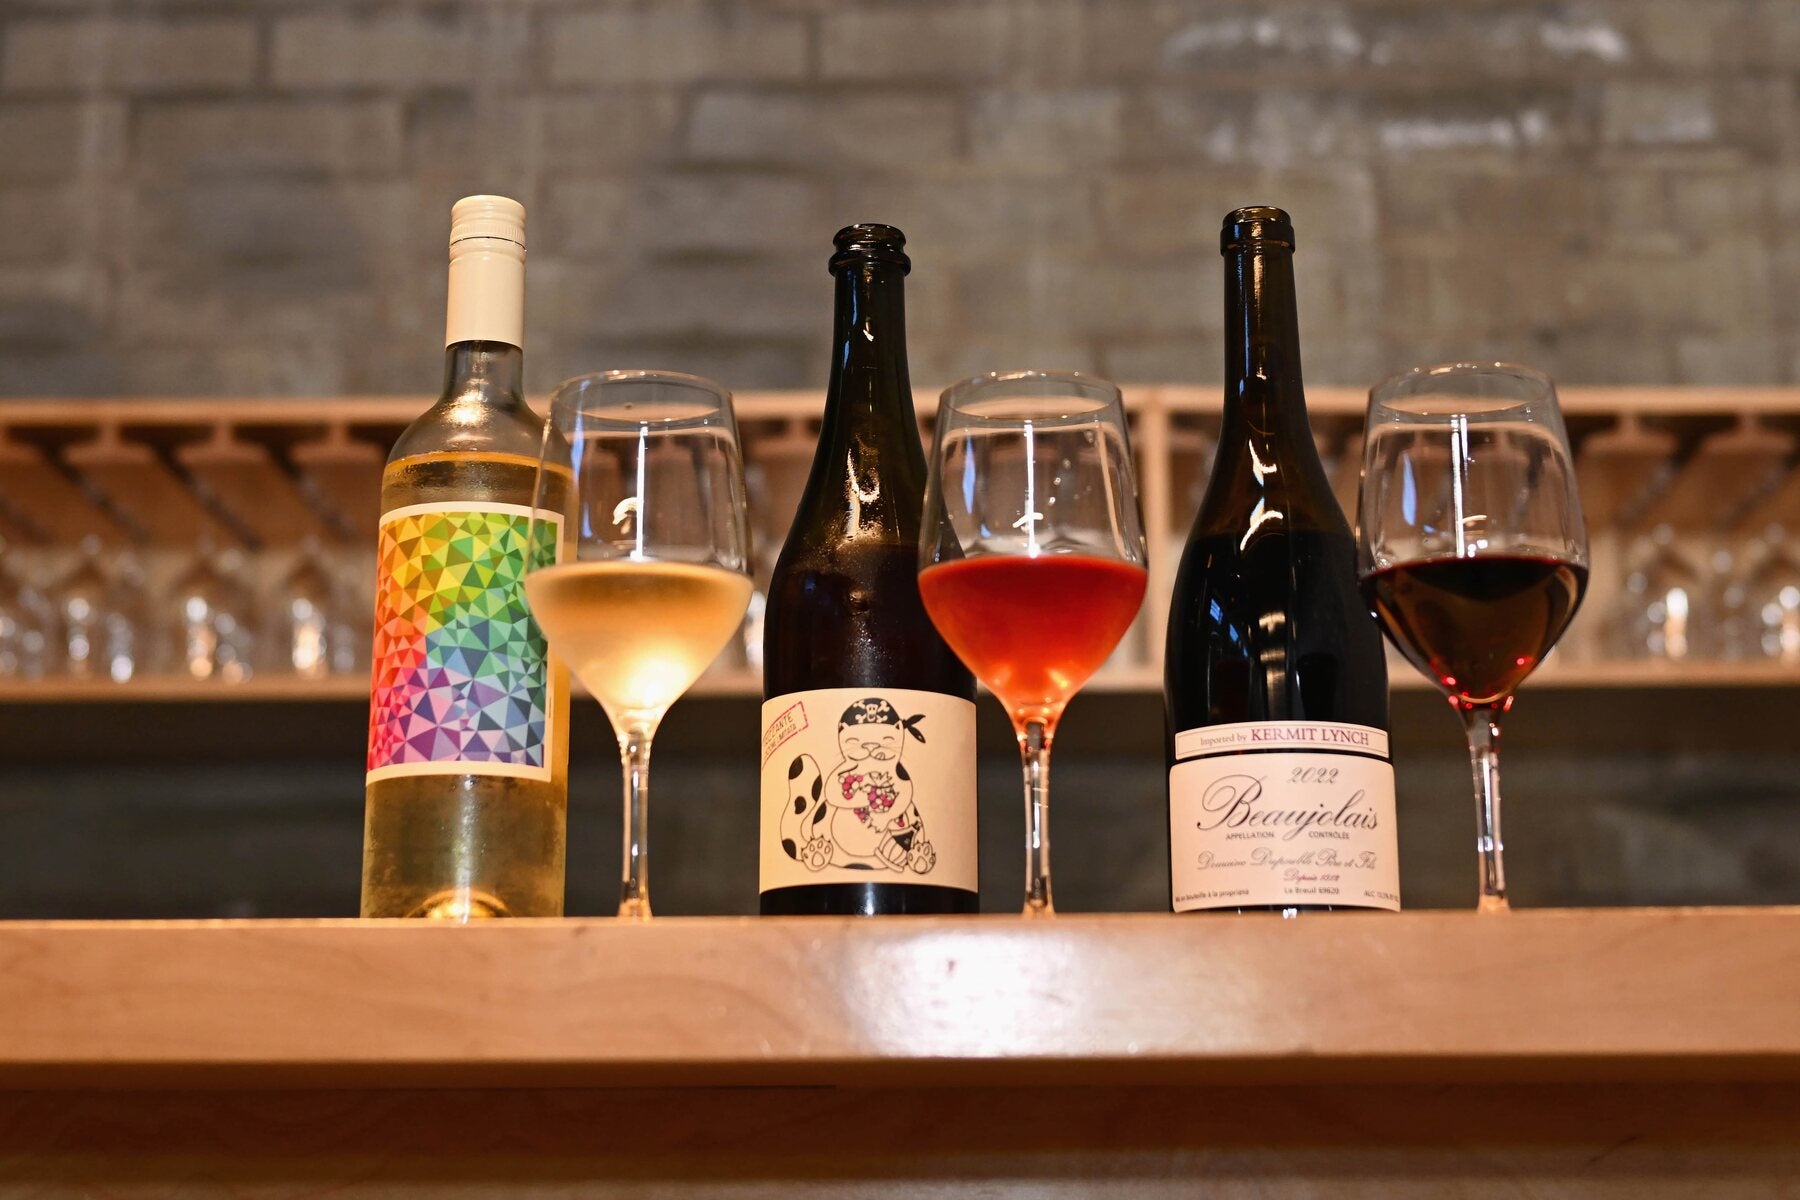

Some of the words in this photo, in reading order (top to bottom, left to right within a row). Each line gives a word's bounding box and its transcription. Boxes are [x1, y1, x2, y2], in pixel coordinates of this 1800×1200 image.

[1200, 734, 1235, 747] Imported
[1237, 734, 1247, 744] by
[1251, 728, 1318, 742] KERMIT
[1322, 728, 1370, 746] LYNCH
[1288, 767, 1339, 785] 2022
[1197, 774, 1378, 841] Beaujolais
[1226, 831, 1274, 841] APPELLATION
